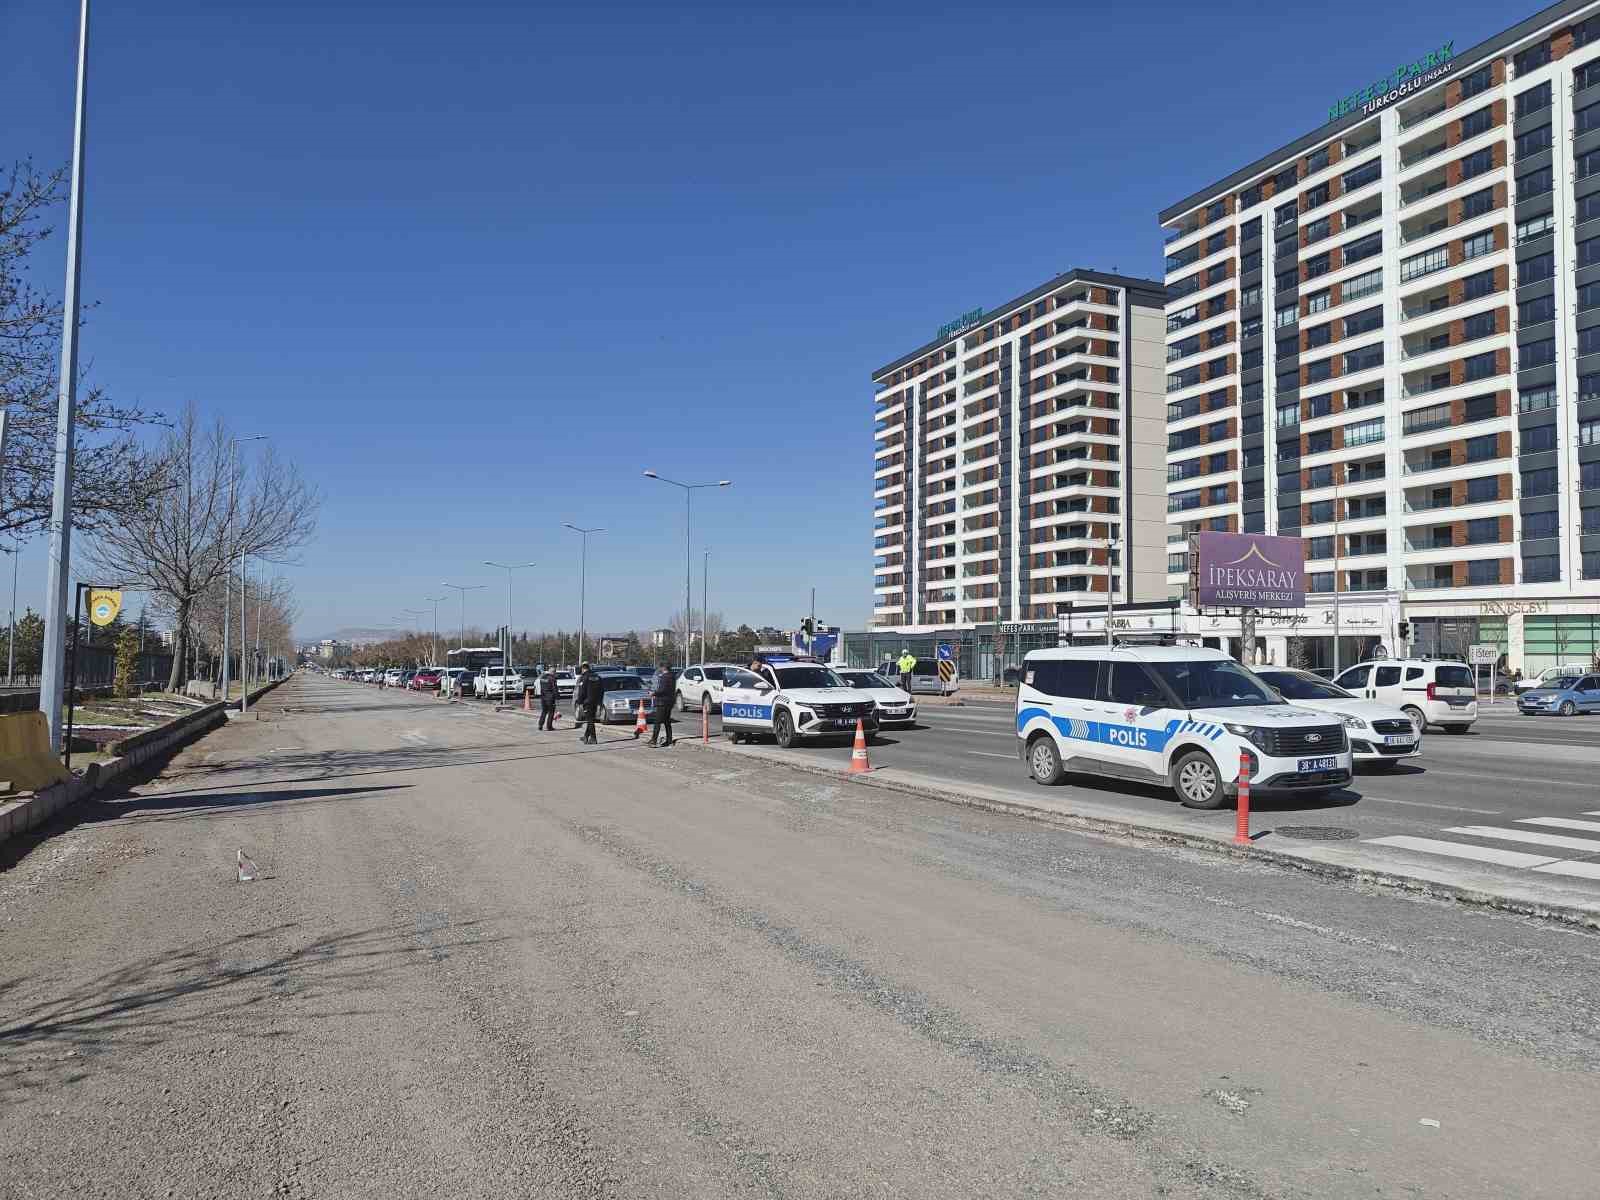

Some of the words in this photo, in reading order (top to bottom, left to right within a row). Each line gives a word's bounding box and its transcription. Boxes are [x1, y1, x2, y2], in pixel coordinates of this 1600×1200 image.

[1395, 40, 1454, 86] PARK
[1209, 563, 1297, 588] İPEKSARAY
[1109, 727, 1147, 746] POLİS
